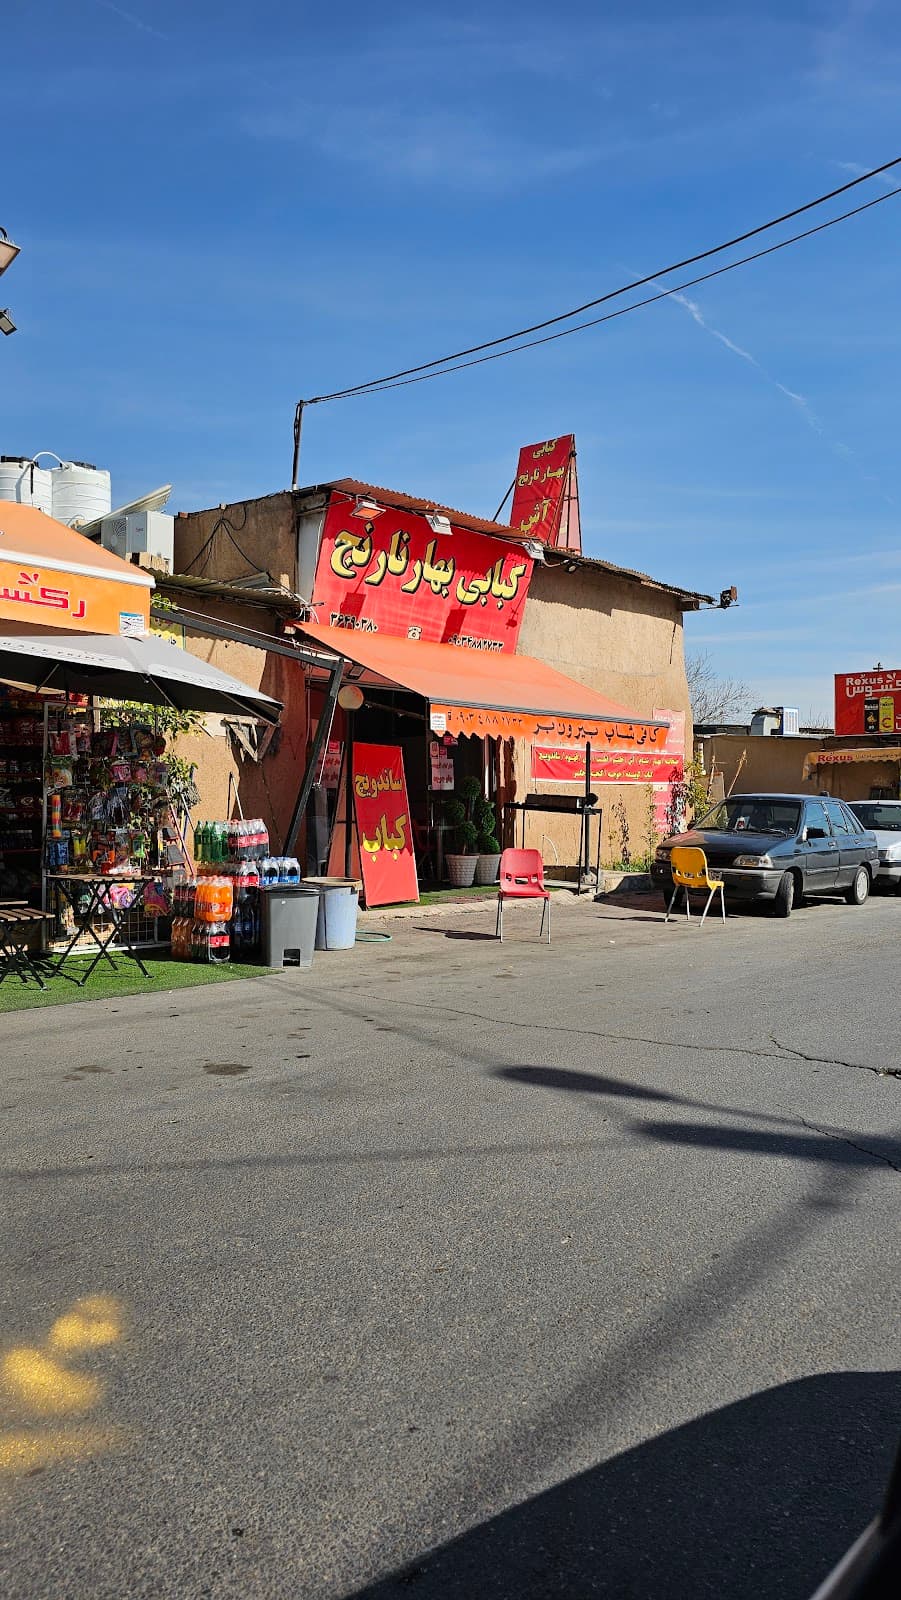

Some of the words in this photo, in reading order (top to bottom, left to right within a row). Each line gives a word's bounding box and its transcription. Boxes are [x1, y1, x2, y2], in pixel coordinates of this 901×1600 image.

[533, 438, 558, 459] کبابی
[456, 558, 526, 609] کبابی
[0, 586, 86, 618] رکس
[605, 724, 635, 743] شاپ
[636, 726, 661, 745] کافی
[354, 767, 403, 798] ساندویچ
[362, 813, 407, 863] کباب
